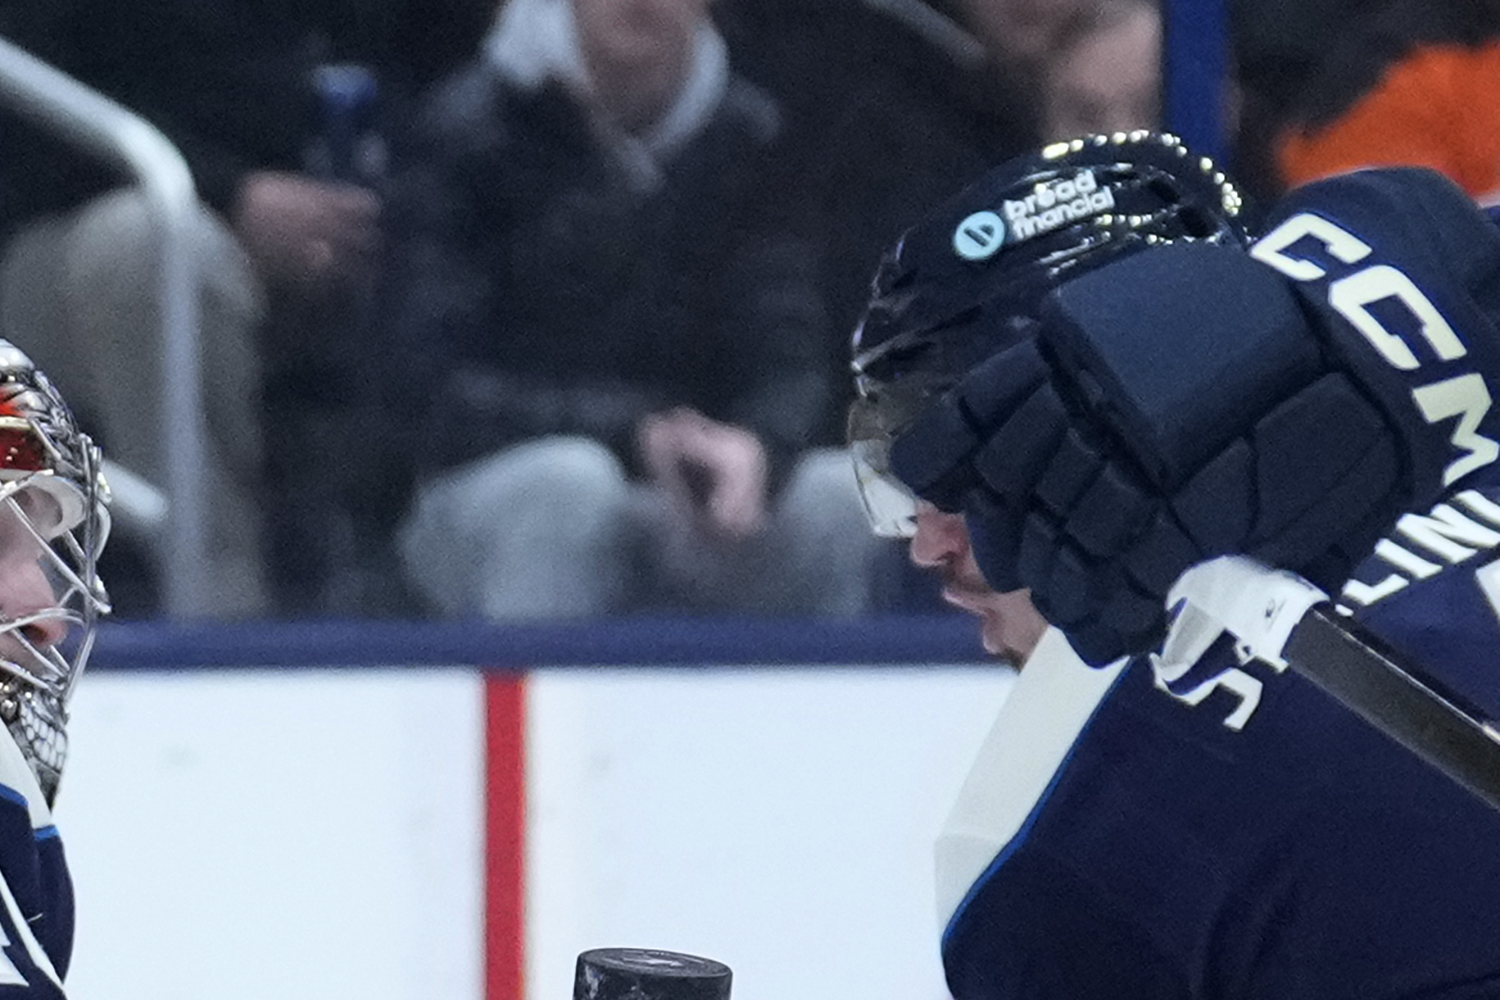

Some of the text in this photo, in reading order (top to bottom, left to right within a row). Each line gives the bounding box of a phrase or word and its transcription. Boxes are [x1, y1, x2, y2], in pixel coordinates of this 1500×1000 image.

[1003, 168, 1097, 223] bread
[1011, 185, 1116, 241] financial
[1249, 212, 1500, 487] CCM
